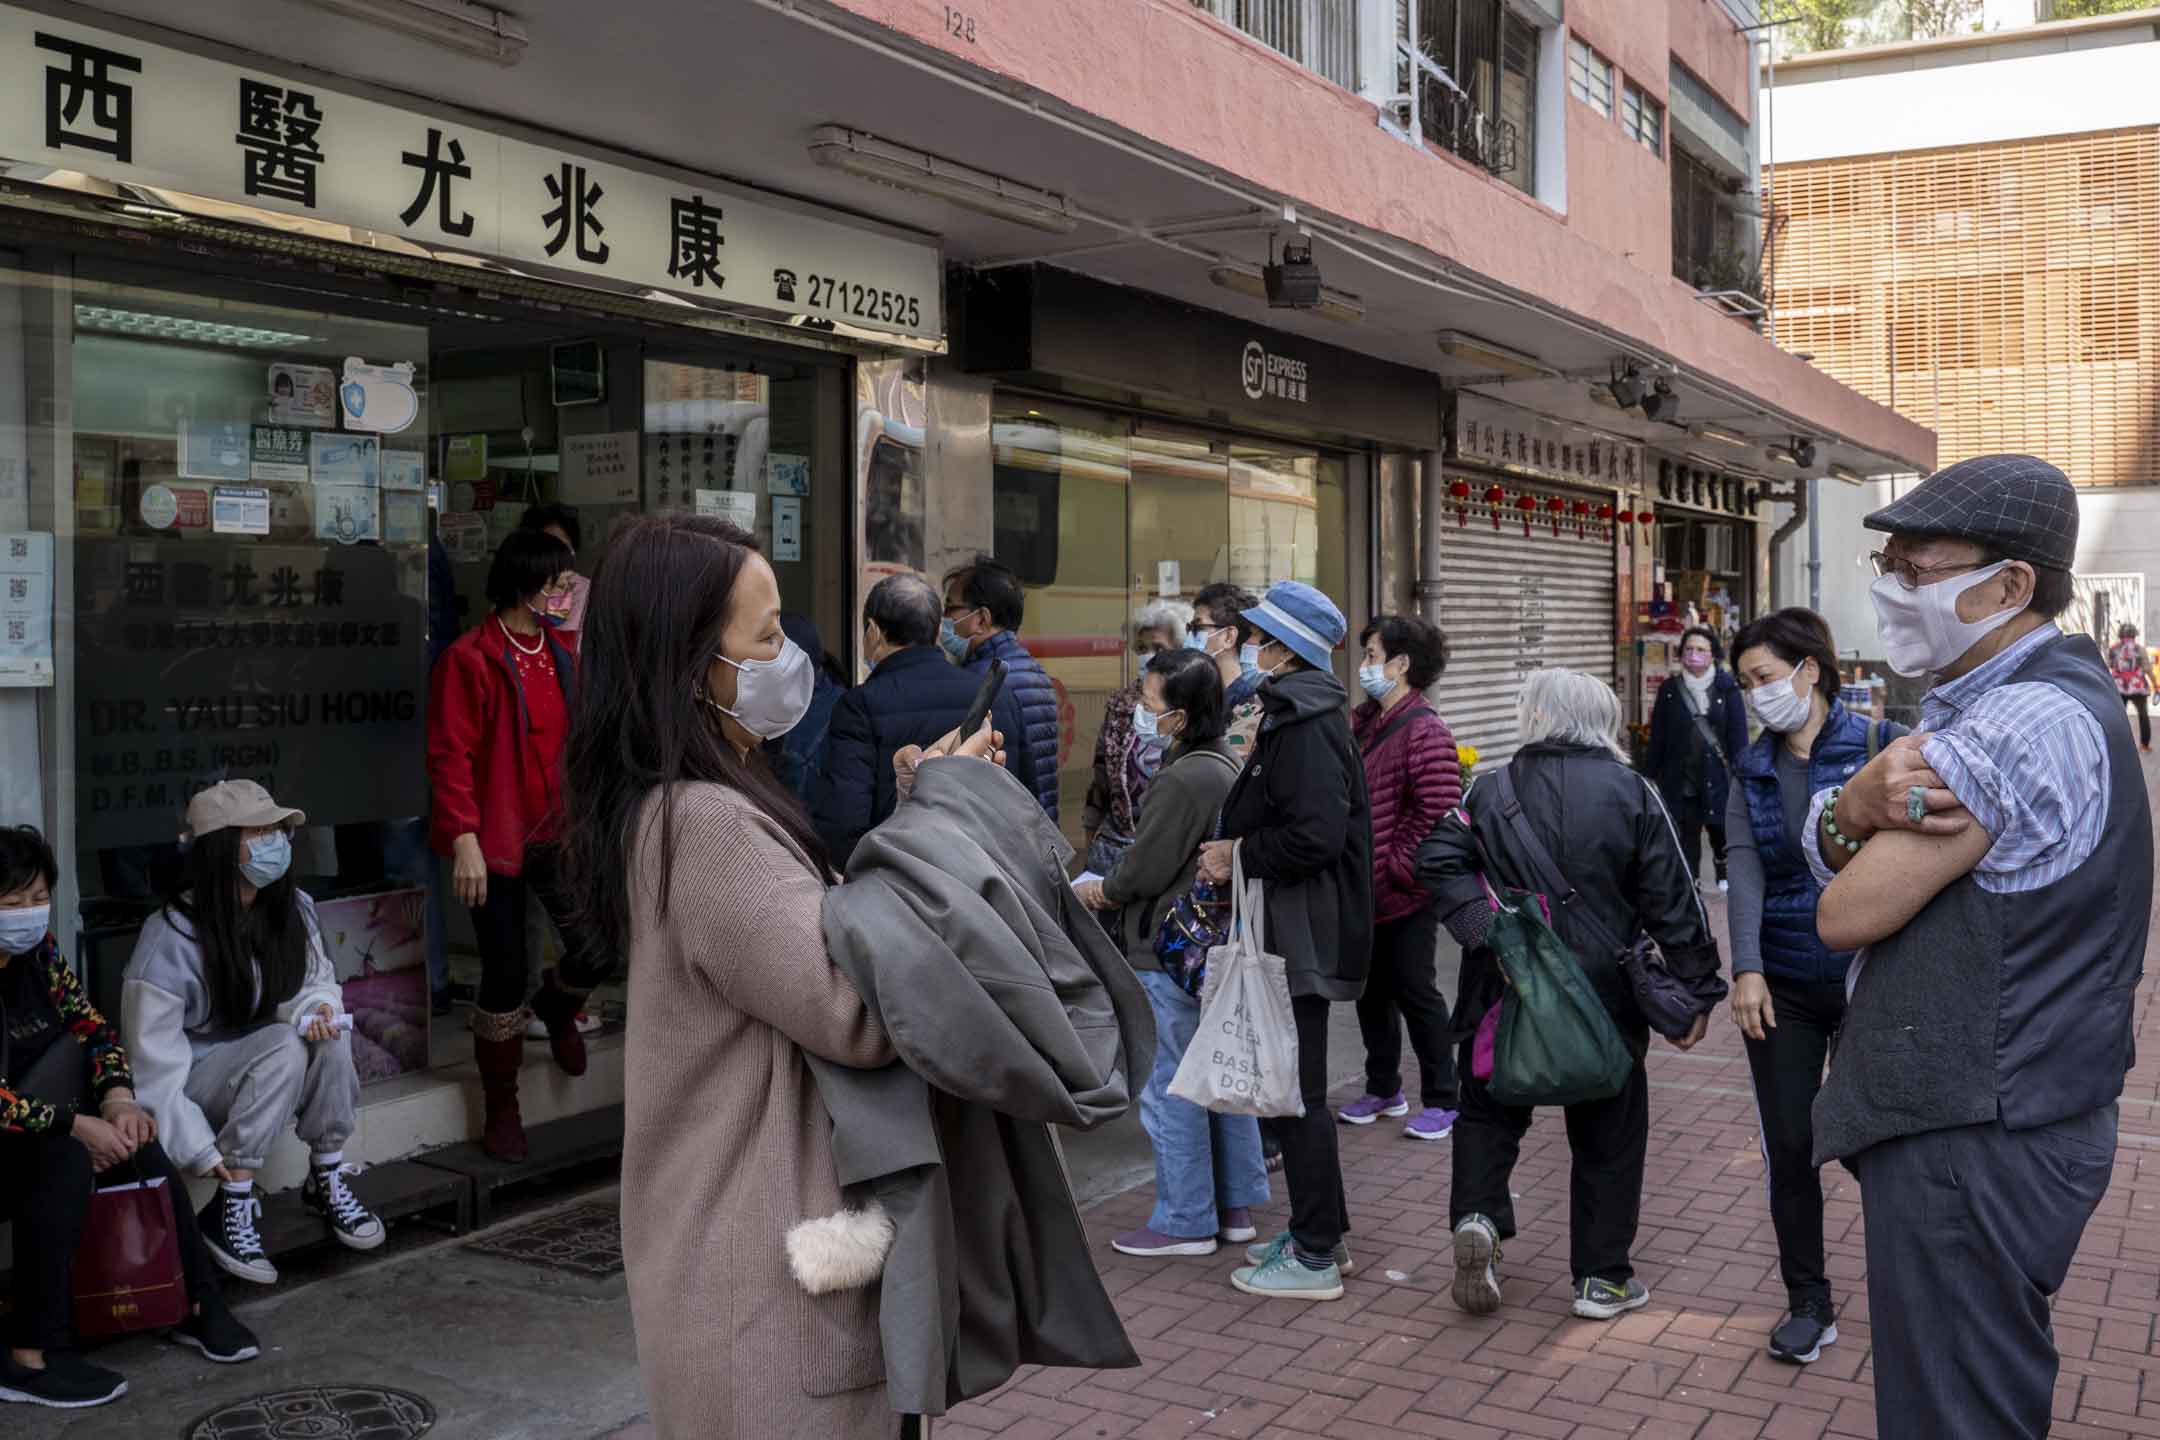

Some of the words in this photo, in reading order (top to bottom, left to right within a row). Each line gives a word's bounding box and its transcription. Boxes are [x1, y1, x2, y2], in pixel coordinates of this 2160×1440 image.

[944, 5, 976, 44] 128
[35, 31, 725, 289] 西醫尤兆康
[807, 273, 920, 327] 27122525
[1267, 353, 1307, 381] EXPRESS
[89, 698, 157, 736] DR.
[168, 694, 241, 731] YAU
[254, 692, 309, 728] SIU
[321, 689, 416, 725] HONG
